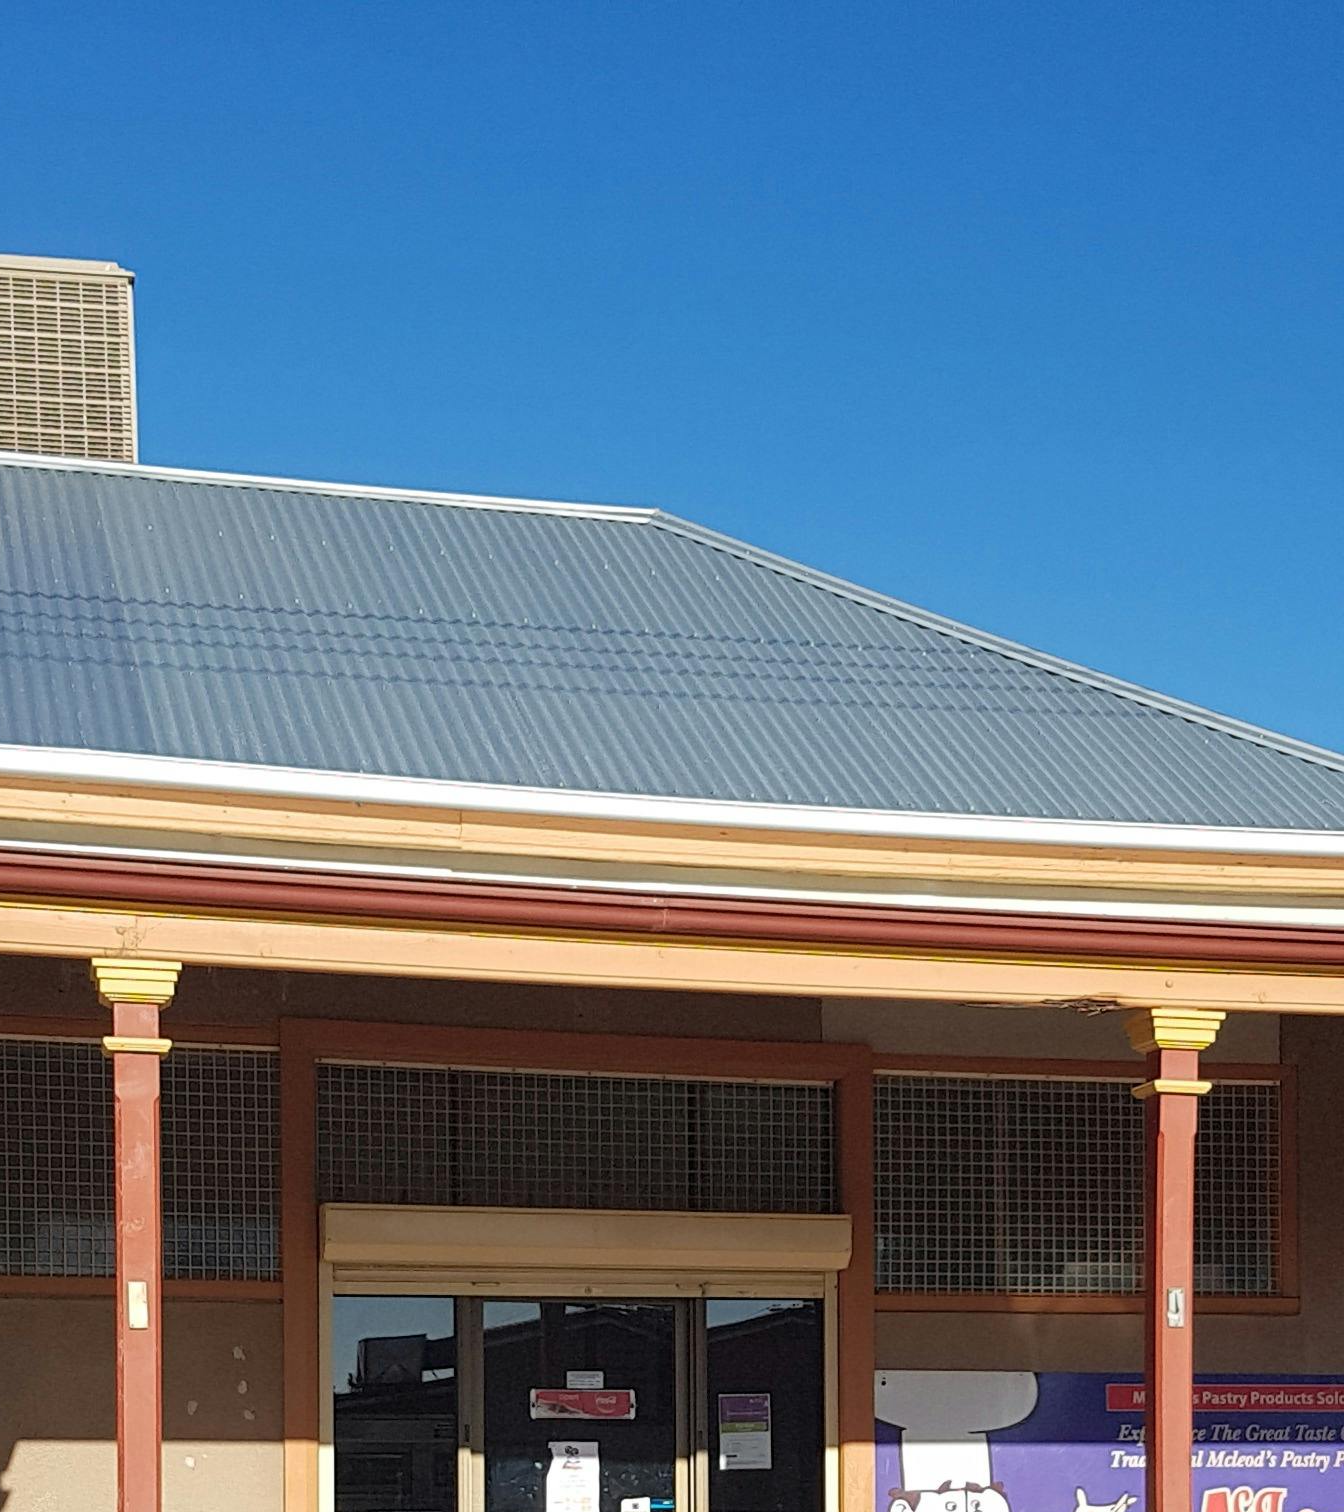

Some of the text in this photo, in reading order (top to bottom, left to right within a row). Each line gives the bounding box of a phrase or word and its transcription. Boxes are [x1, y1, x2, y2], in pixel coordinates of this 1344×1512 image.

[1203, 1391, 1246, 1408] Pastry
[1250, 1390, 1313, 1405] Products
[1210, 1425, 1242, 1441] The
[1245, 1425, 1290, 1441] Great
[1295, 1425, 1336, 1441] Taste
[1206, 1450, 1277, 1468] Mcleod's
[1280, 1451, 1330, 1473] Pastry
